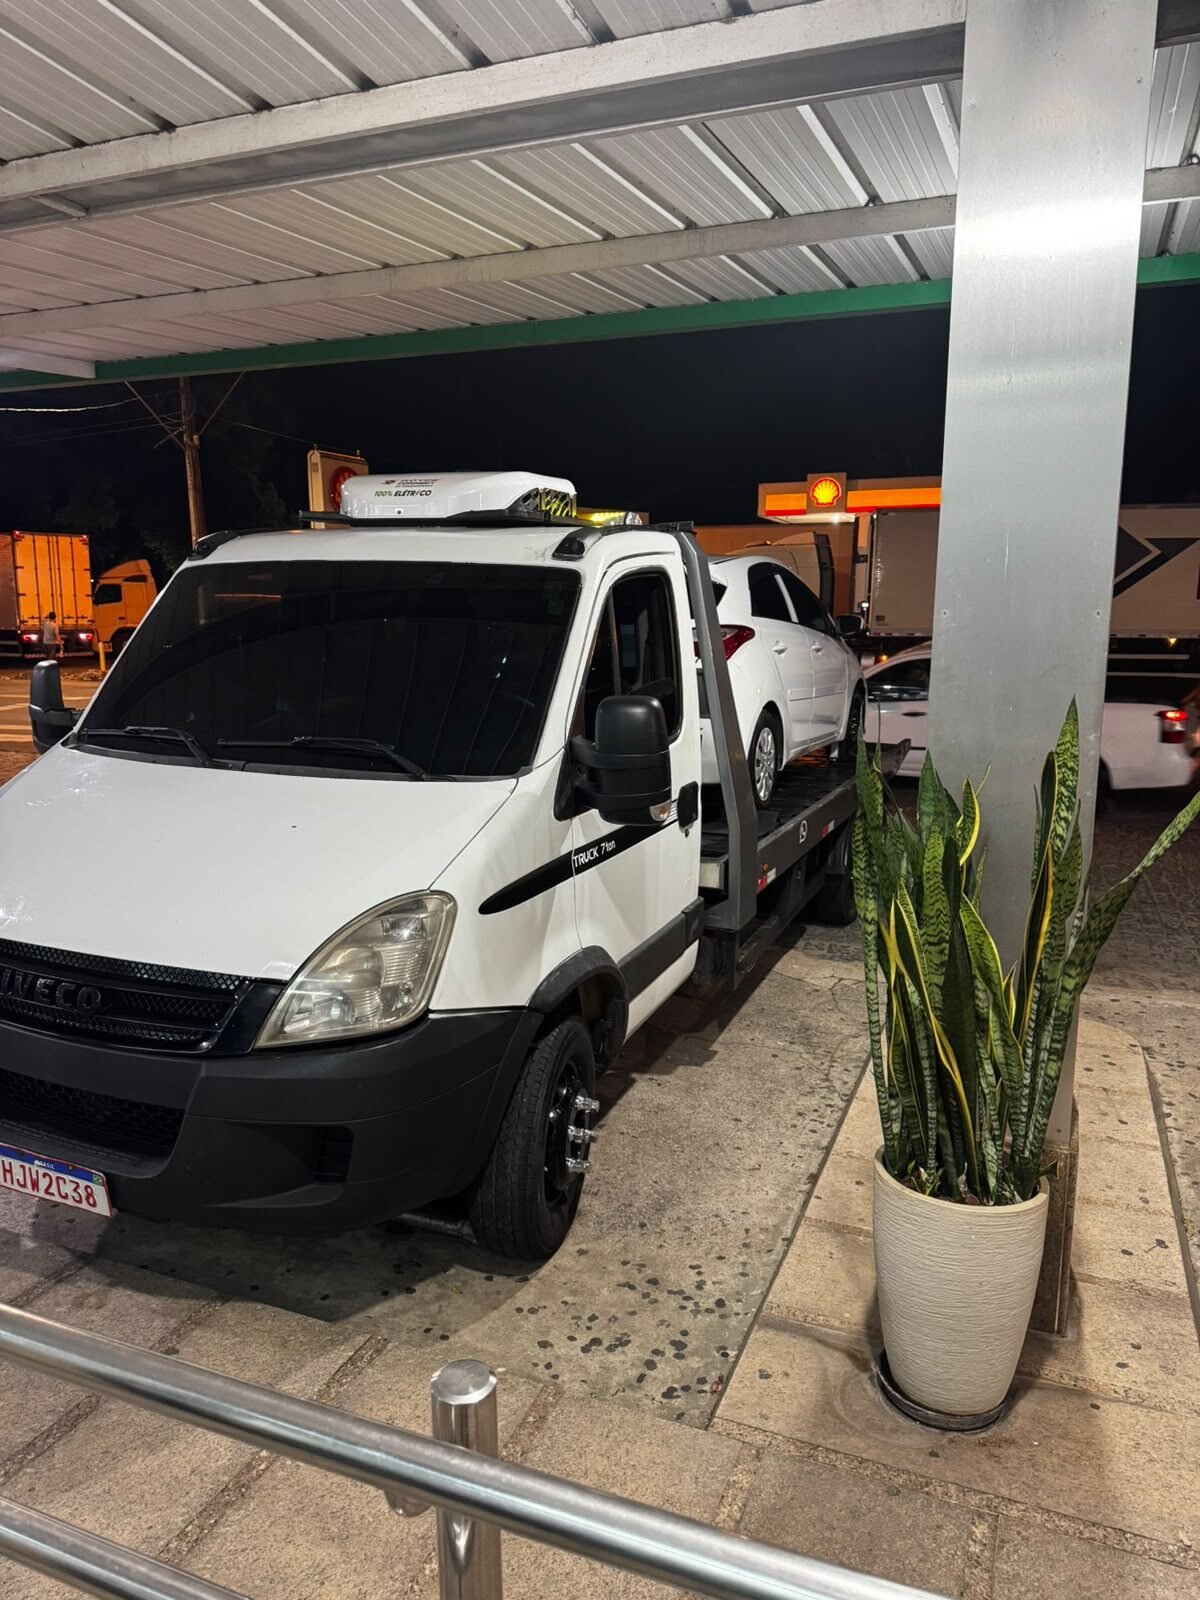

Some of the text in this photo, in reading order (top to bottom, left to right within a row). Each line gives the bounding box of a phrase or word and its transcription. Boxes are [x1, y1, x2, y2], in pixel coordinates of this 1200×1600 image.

[394, 489, 432, 497] ELÉTRICO
[573, 846, 599, 868] TRUCK
[1, 1159, 98, 1208] HJW2C38
